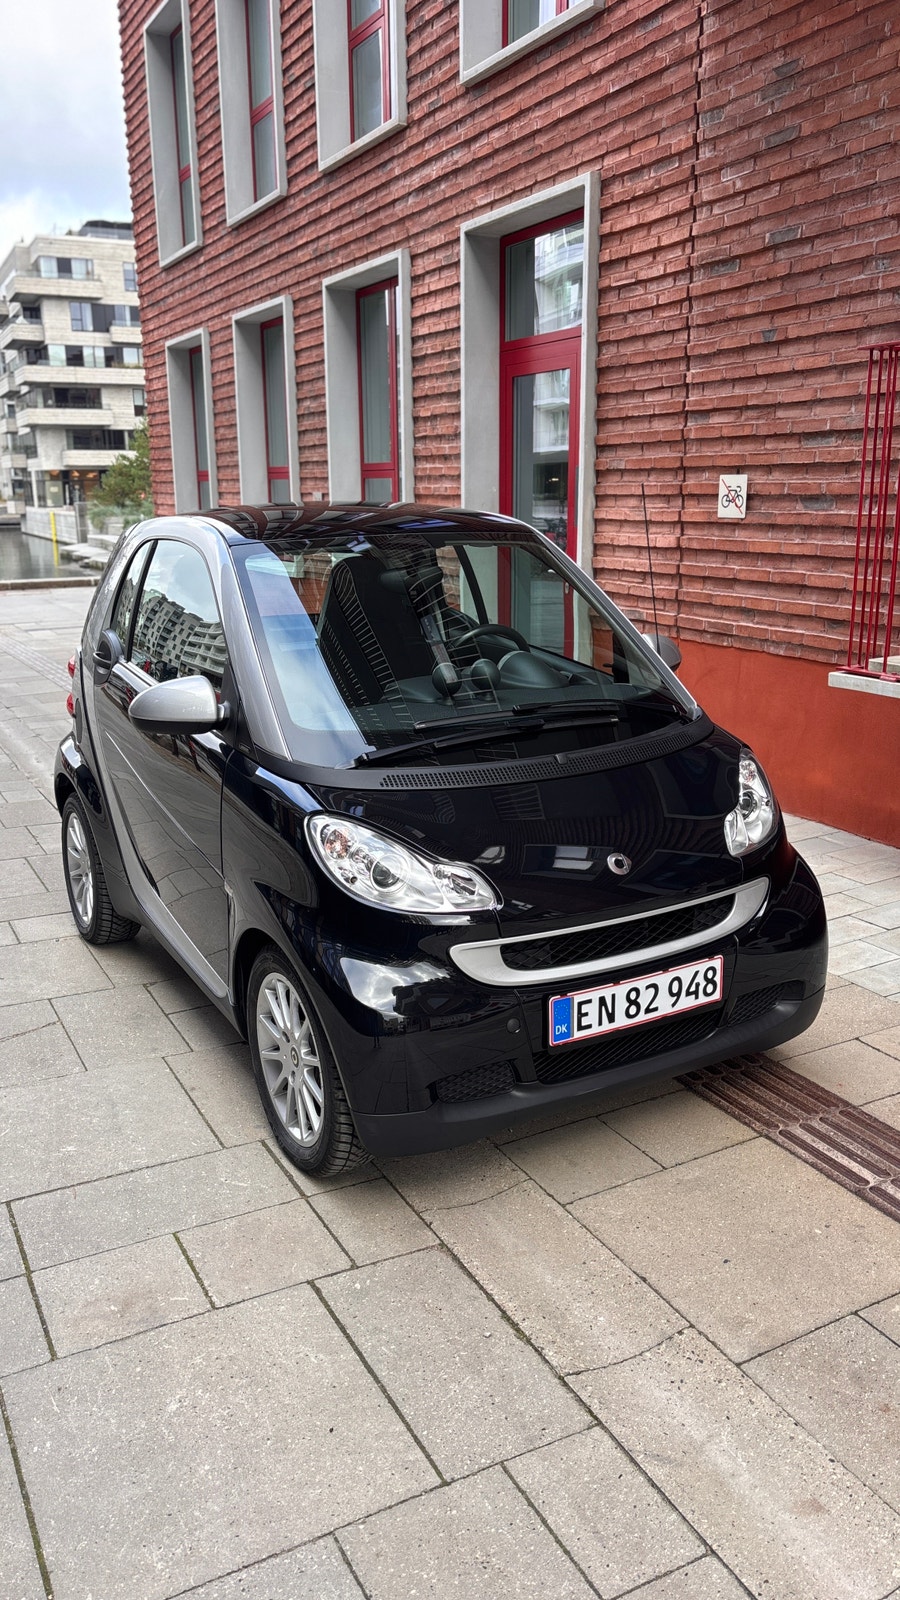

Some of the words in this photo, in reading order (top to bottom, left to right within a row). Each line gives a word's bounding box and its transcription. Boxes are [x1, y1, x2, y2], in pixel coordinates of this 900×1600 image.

[576, 993, 616, 1032] EN
[624, 983, 660, 1019] 82
[667, 966, 718, 1008] 948
[555, 1024, 568, 1035] DK
